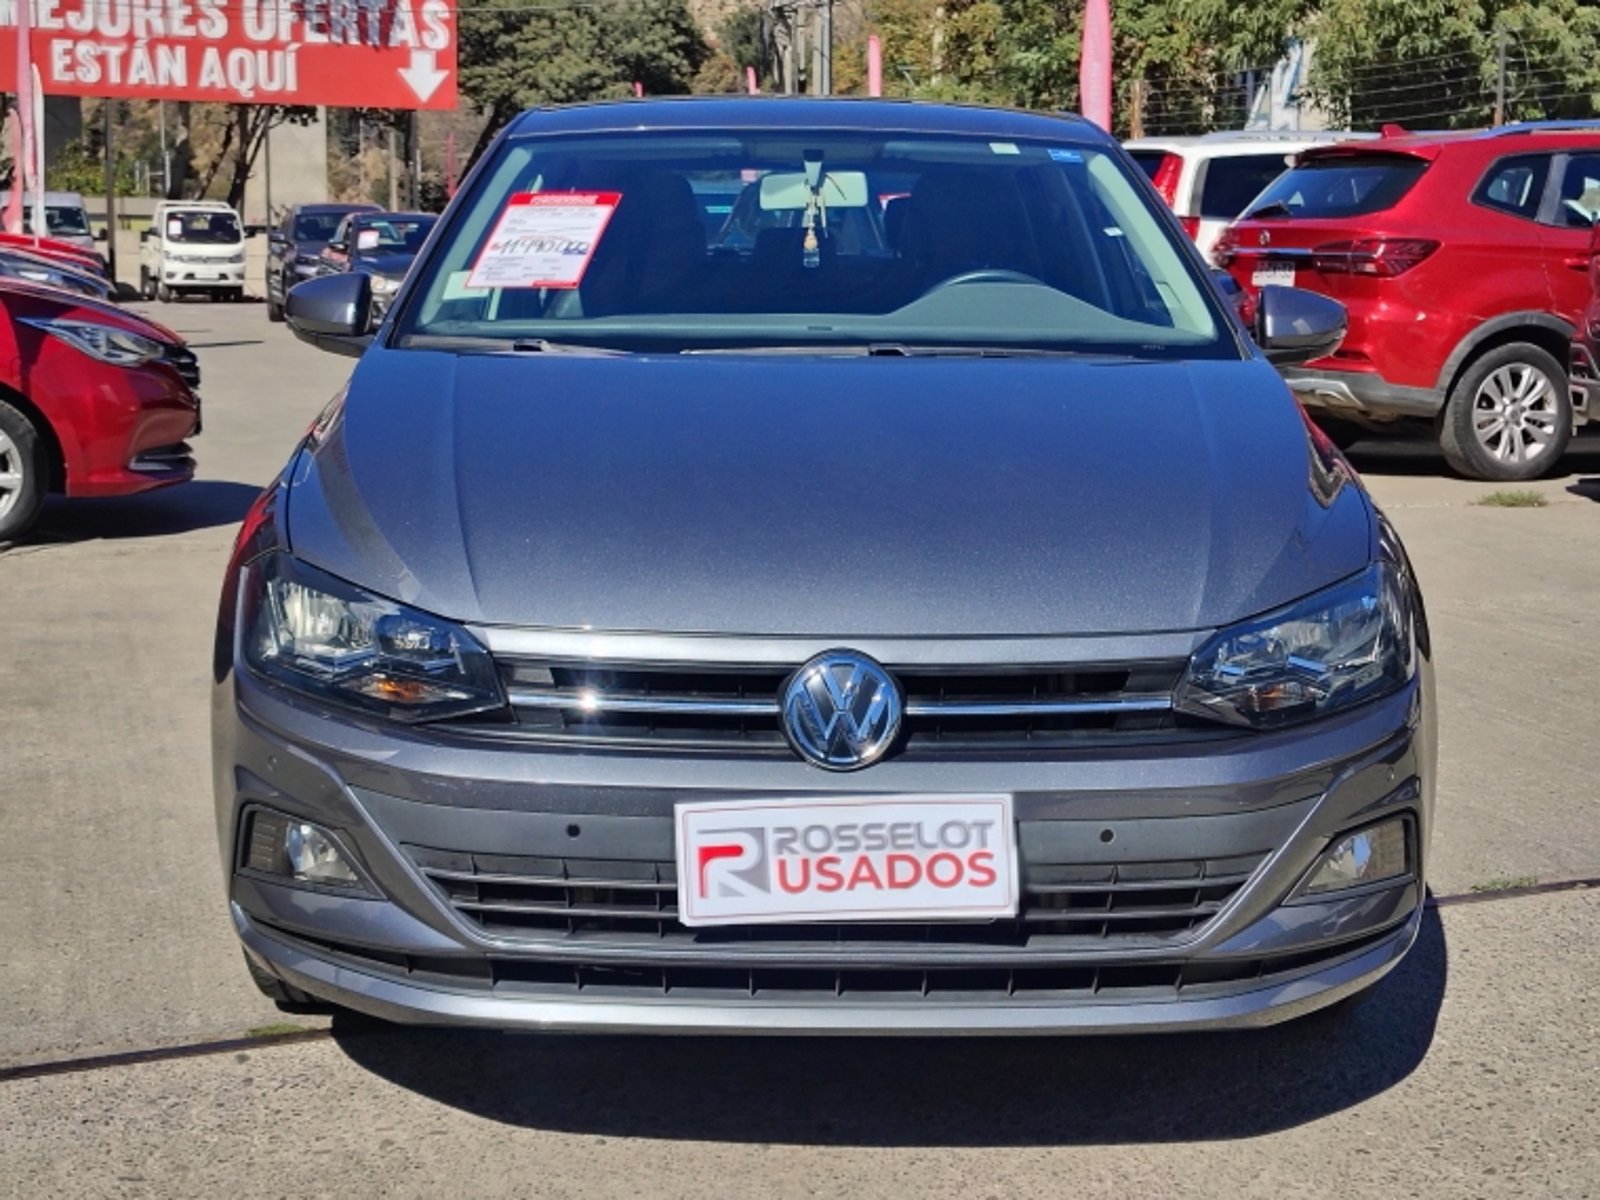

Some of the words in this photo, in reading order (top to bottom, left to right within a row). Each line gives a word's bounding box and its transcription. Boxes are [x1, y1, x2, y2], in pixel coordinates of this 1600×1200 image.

[243, 0, 450, 50] OFERTAS
[51, 36, 187, 88] ESTÁN
[200, 43, 302, 97] AQUÍ
[773, 819, 995, 855] ROSSELOT
[778, 852, 997, 894] USADOS
